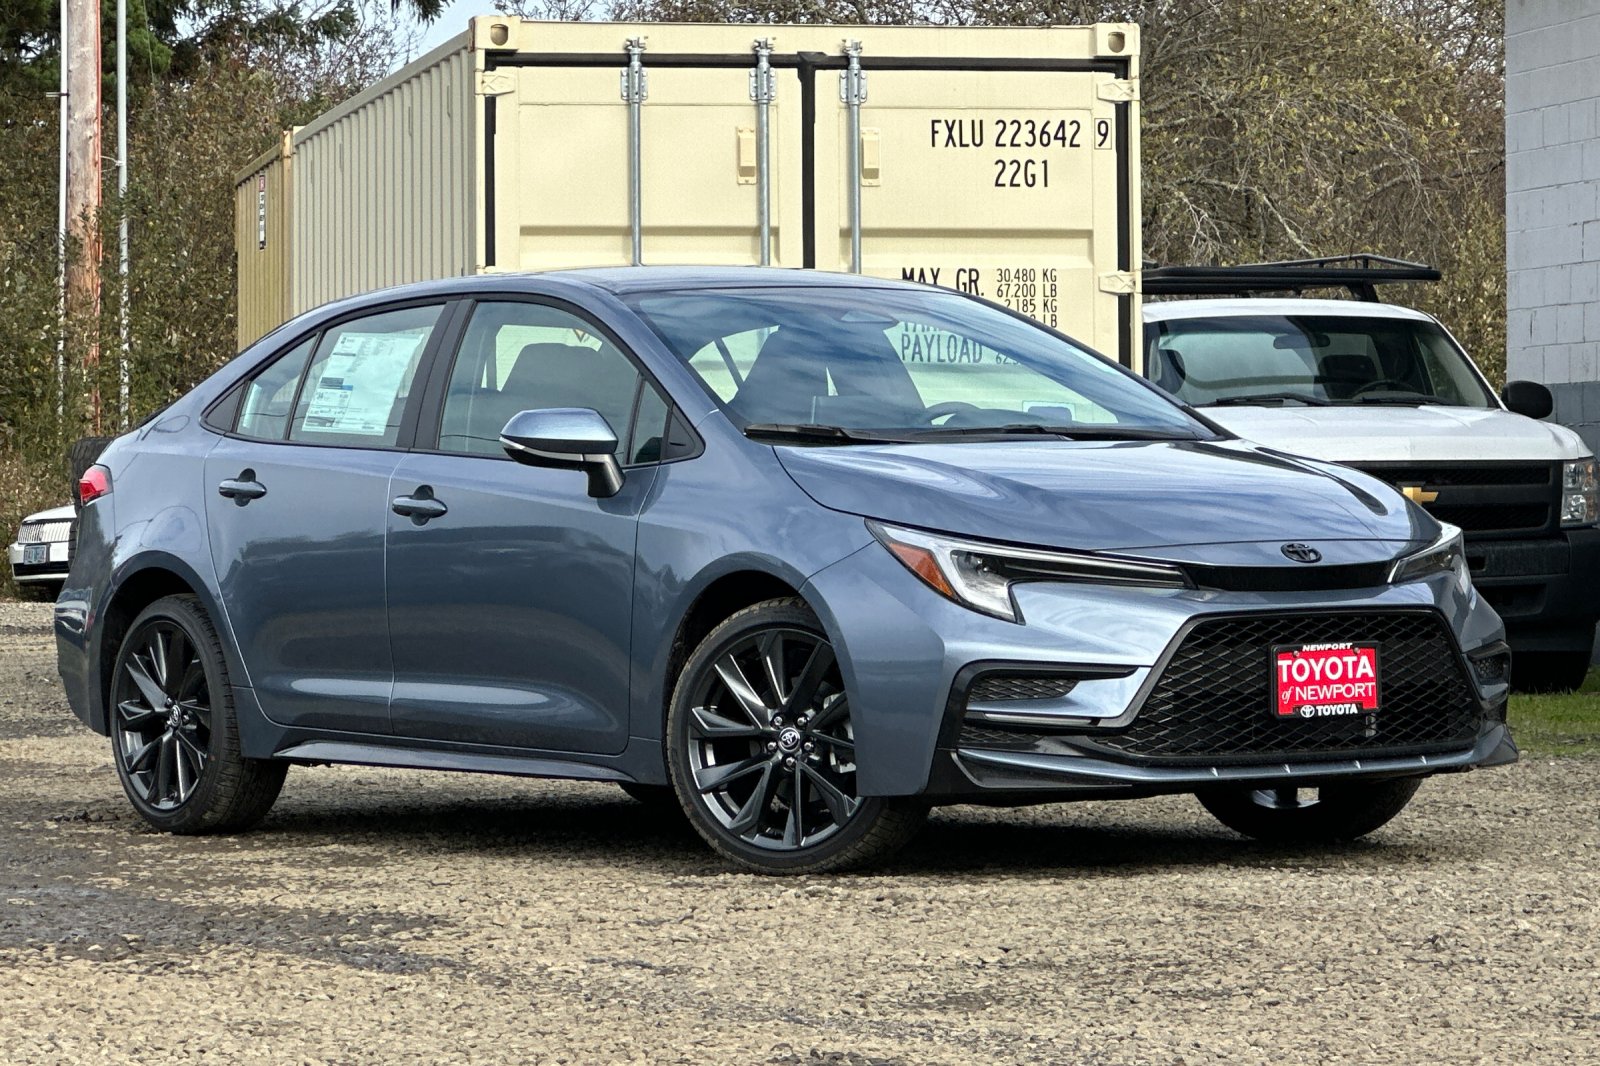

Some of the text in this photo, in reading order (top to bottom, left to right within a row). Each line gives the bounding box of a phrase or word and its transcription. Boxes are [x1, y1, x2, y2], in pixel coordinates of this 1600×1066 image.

[931, 119, 1109, 148] FXLU 223642 9
[994, 159, 1049, 188] 22G1
[956, 267, 985, 297] GR.
[1042, 268, 1057, 283] KG
[1042, 283, 1057, 298] LB
[1042, 298, 1057, 313] KG
[901, 333, 983, 363] PAYLOAD
[1302, 642, 1353, 652] NEWPORT
[1278, 655, 1375, 683] TOYOTA
[1281, 682, 1376, 704] of NEWPORT
[1315, 703, 1359, 716] TOYOTA
